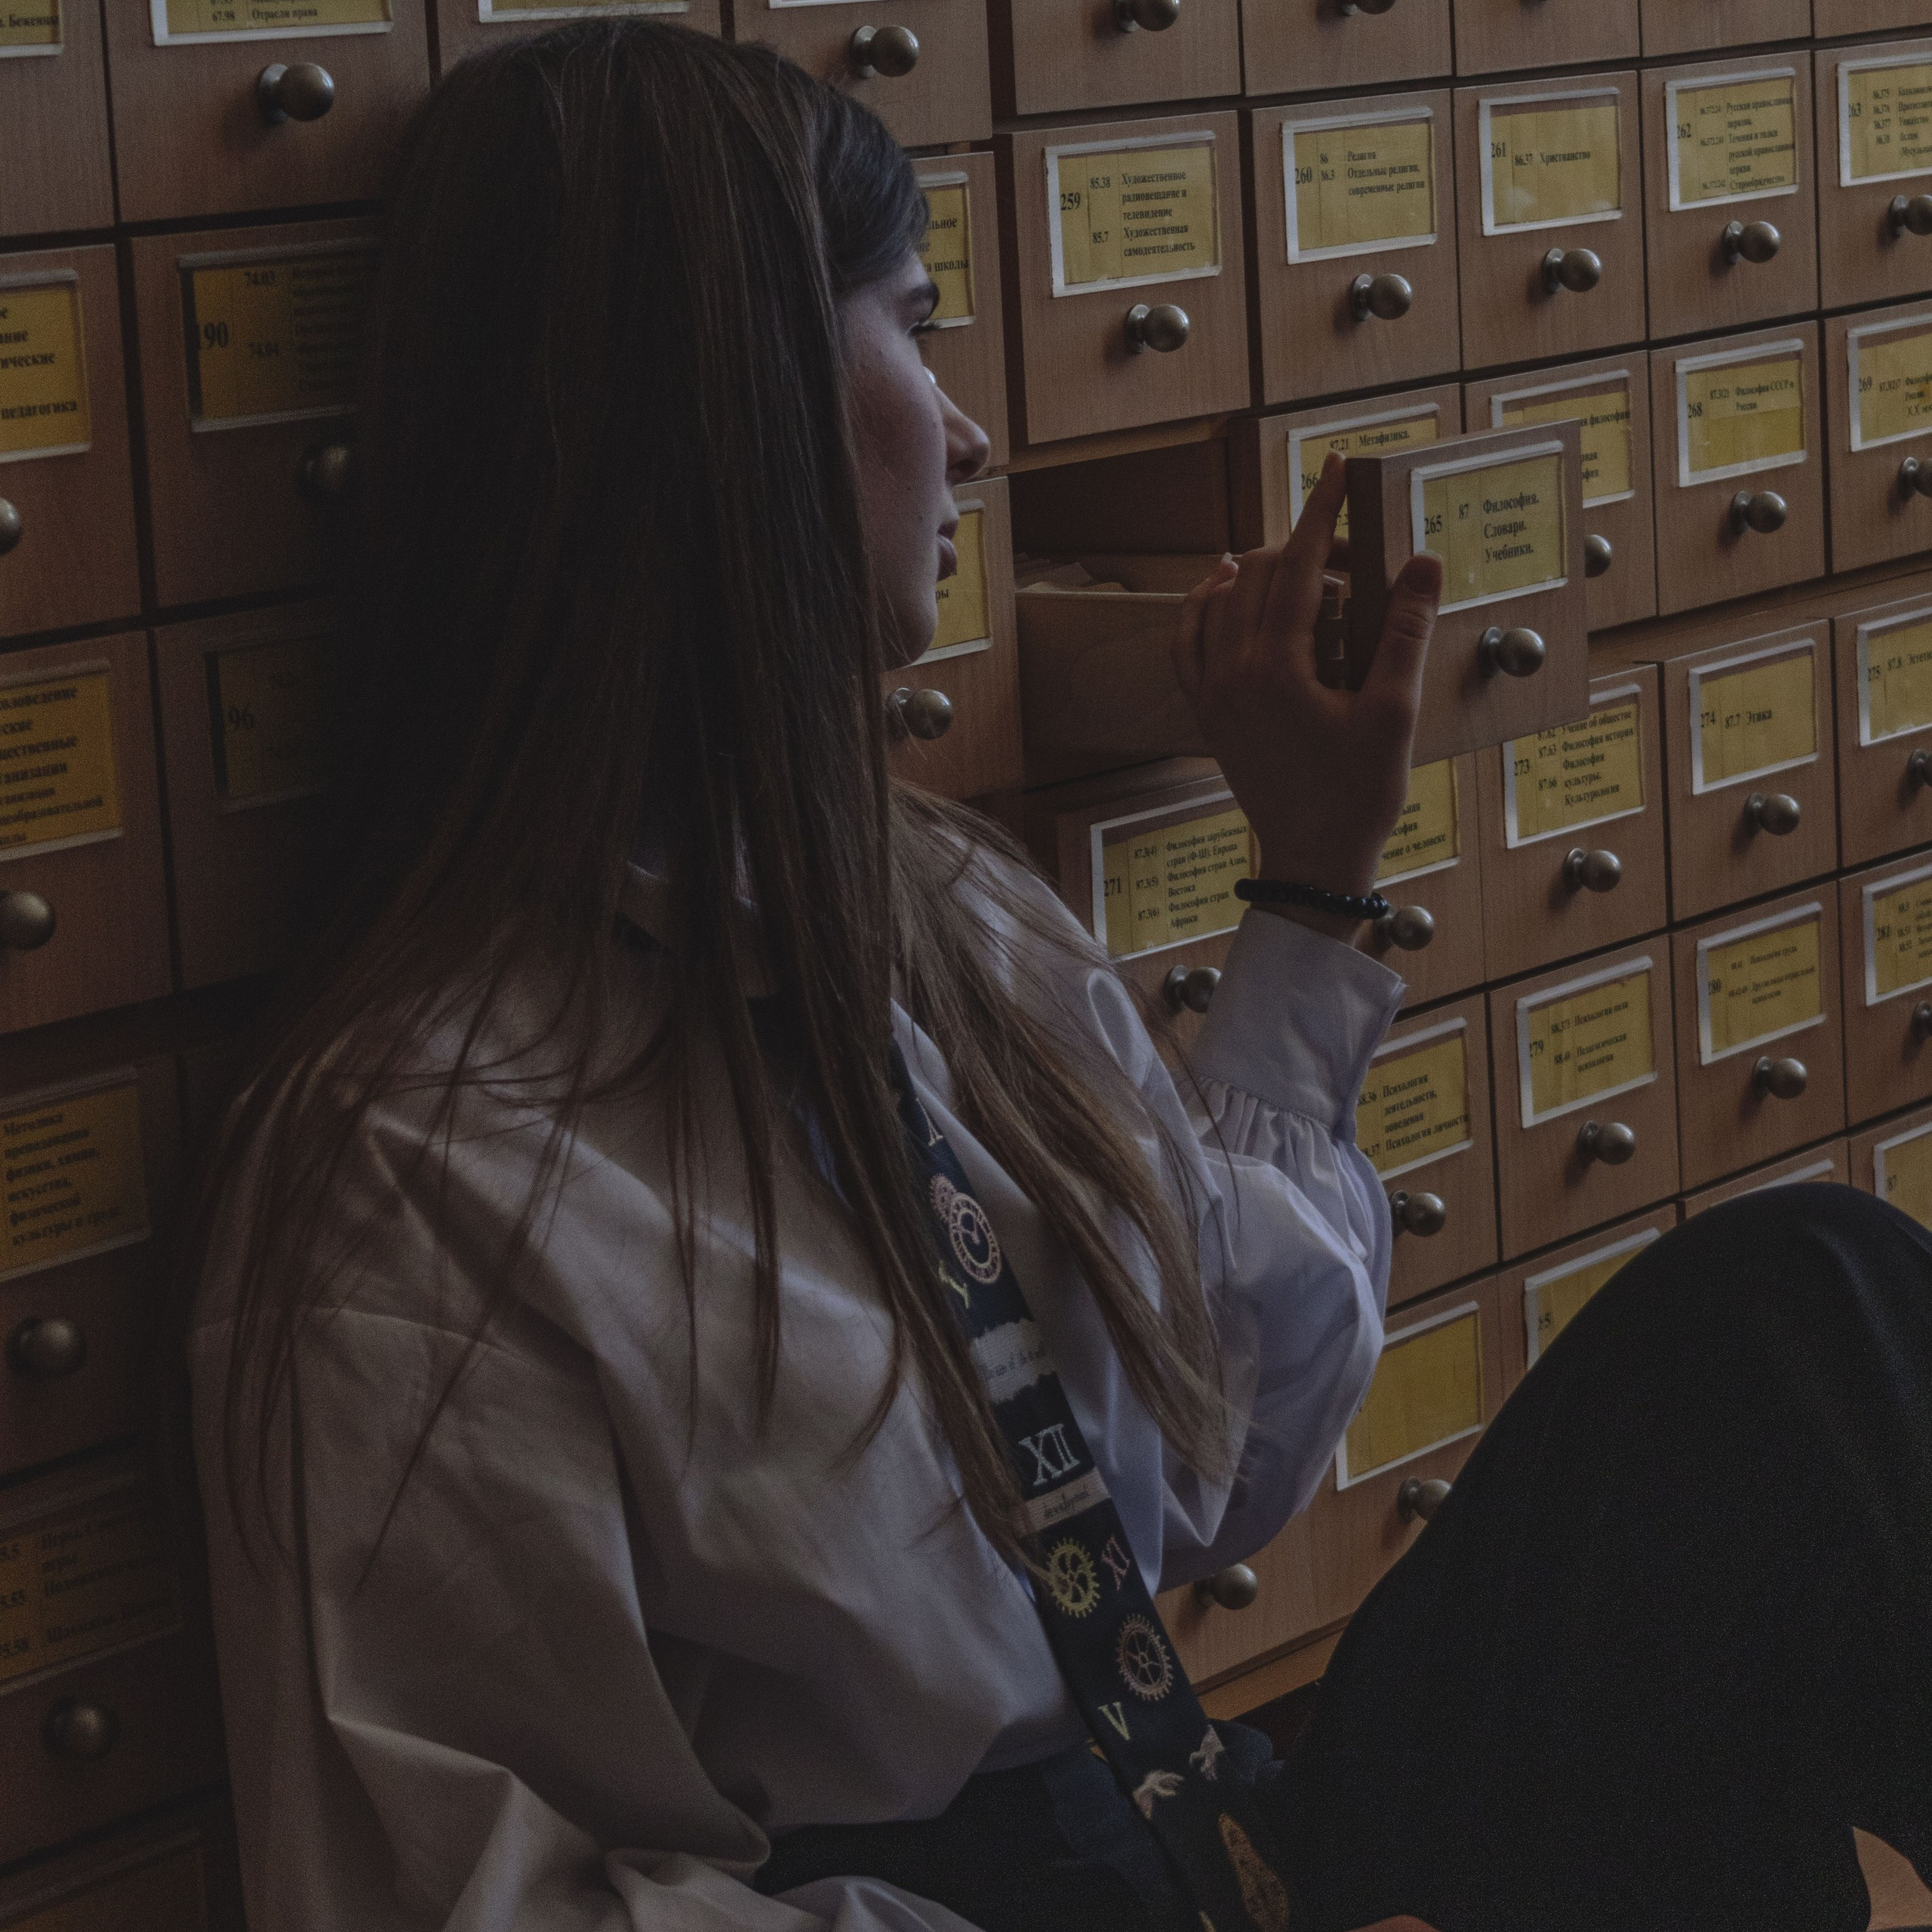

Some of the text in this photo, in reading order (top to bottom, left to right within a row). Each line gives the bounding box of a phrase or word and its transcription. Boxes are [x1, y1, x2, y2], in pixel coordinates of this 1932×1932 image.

[1347, 150, 1377, 162] Религия
[1491, 142, 1506, 158] 261
[1540, 151, 1591, 165] Христианство
[1090, 171, 1186, 189] 85.38 Художественное
[1295, 167, 1313, 185] 260
[1347, 166, 1387, 179] Отдельные
[1060, 192, 1081, 211] 259
[1122, 190, 1180, 205] радиовещание
[1123, 208, 1173, 221] телевидение
[1092, 224, 1189, 244] 85.7 Художественная
[1124, 242, 1195, 257] самодеятельность
[199, 321, 229, 350] 90
[1687, 401, 1703, 419] 268
[1458, 491, 1540, 520] 87 Философия.
[1423, 513, 1443, 536] 265
[1485, 542, 1534, 564] Учебники.
[1746, 709, 1773, 726] Этика
[1561, 734, 1604, 752] Философия
[1563, 751, 1604, 771] Философия
[1166, 835, 1205, 852] Философия
[1213, 841, 1238, 857] Европа
[1412, 833, 1447, 851] человеке
[1168, 864, 1206, 883] Философия
[1103, 875, 1122, 897] 271
[1168, 884, 1196, 899] Востока
[1168, 896, 1208, 913] Философия
[1383, 1072, 1429, 1098] Психология
[1384, 1112, 1424, 1134] поведения
[1386, 1128, 1432, 1152] Психология
[1019, 1422, 1081, 1487] XII
[1098, 1700, 1131, 1741] V
